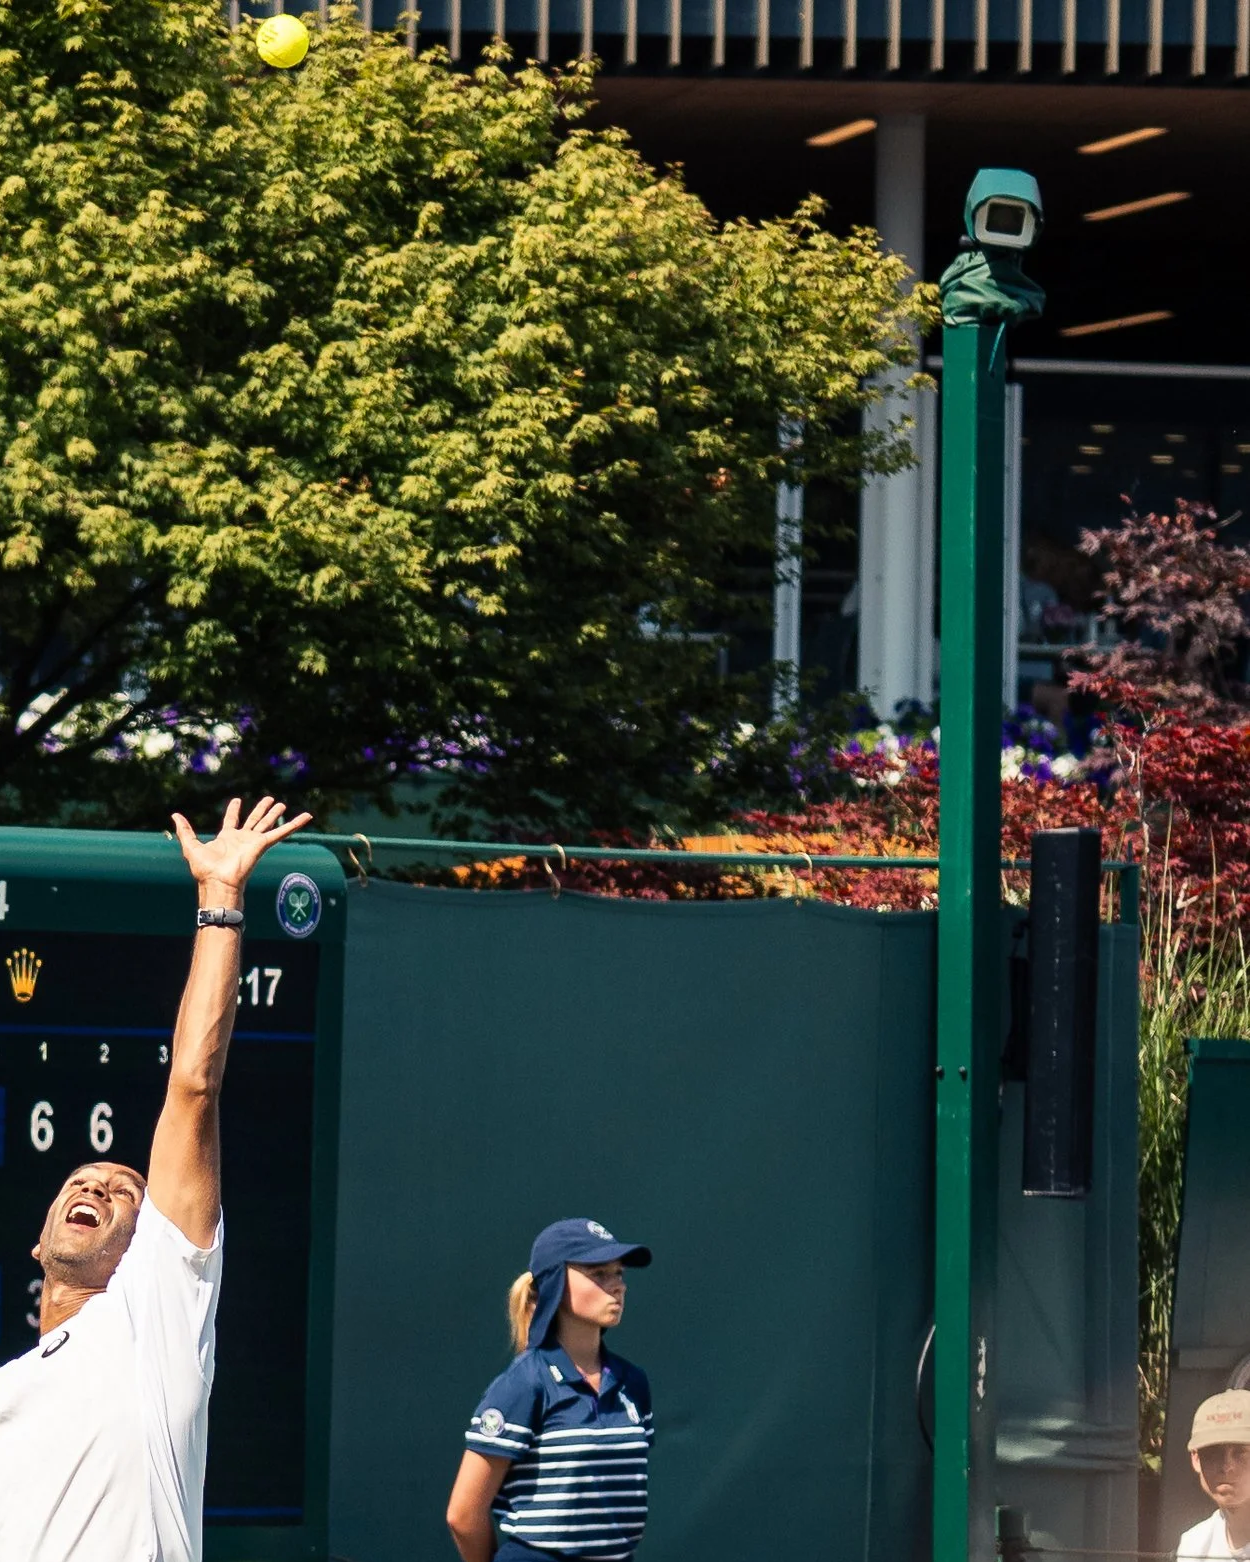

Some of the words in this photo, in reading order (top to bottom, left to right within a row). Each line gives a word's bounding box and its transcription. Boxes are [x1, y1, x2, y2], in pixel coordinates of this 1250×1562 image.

[237, 966, 283, 1006] :17
[38, 1041, 48, 1061] 1
[99, 1042, 110, 1064] 2
[158, 1044, 169, 1064] 3
[30, 1100, 55, 1152] 6
[89, 1102, 114, 1153] 6
